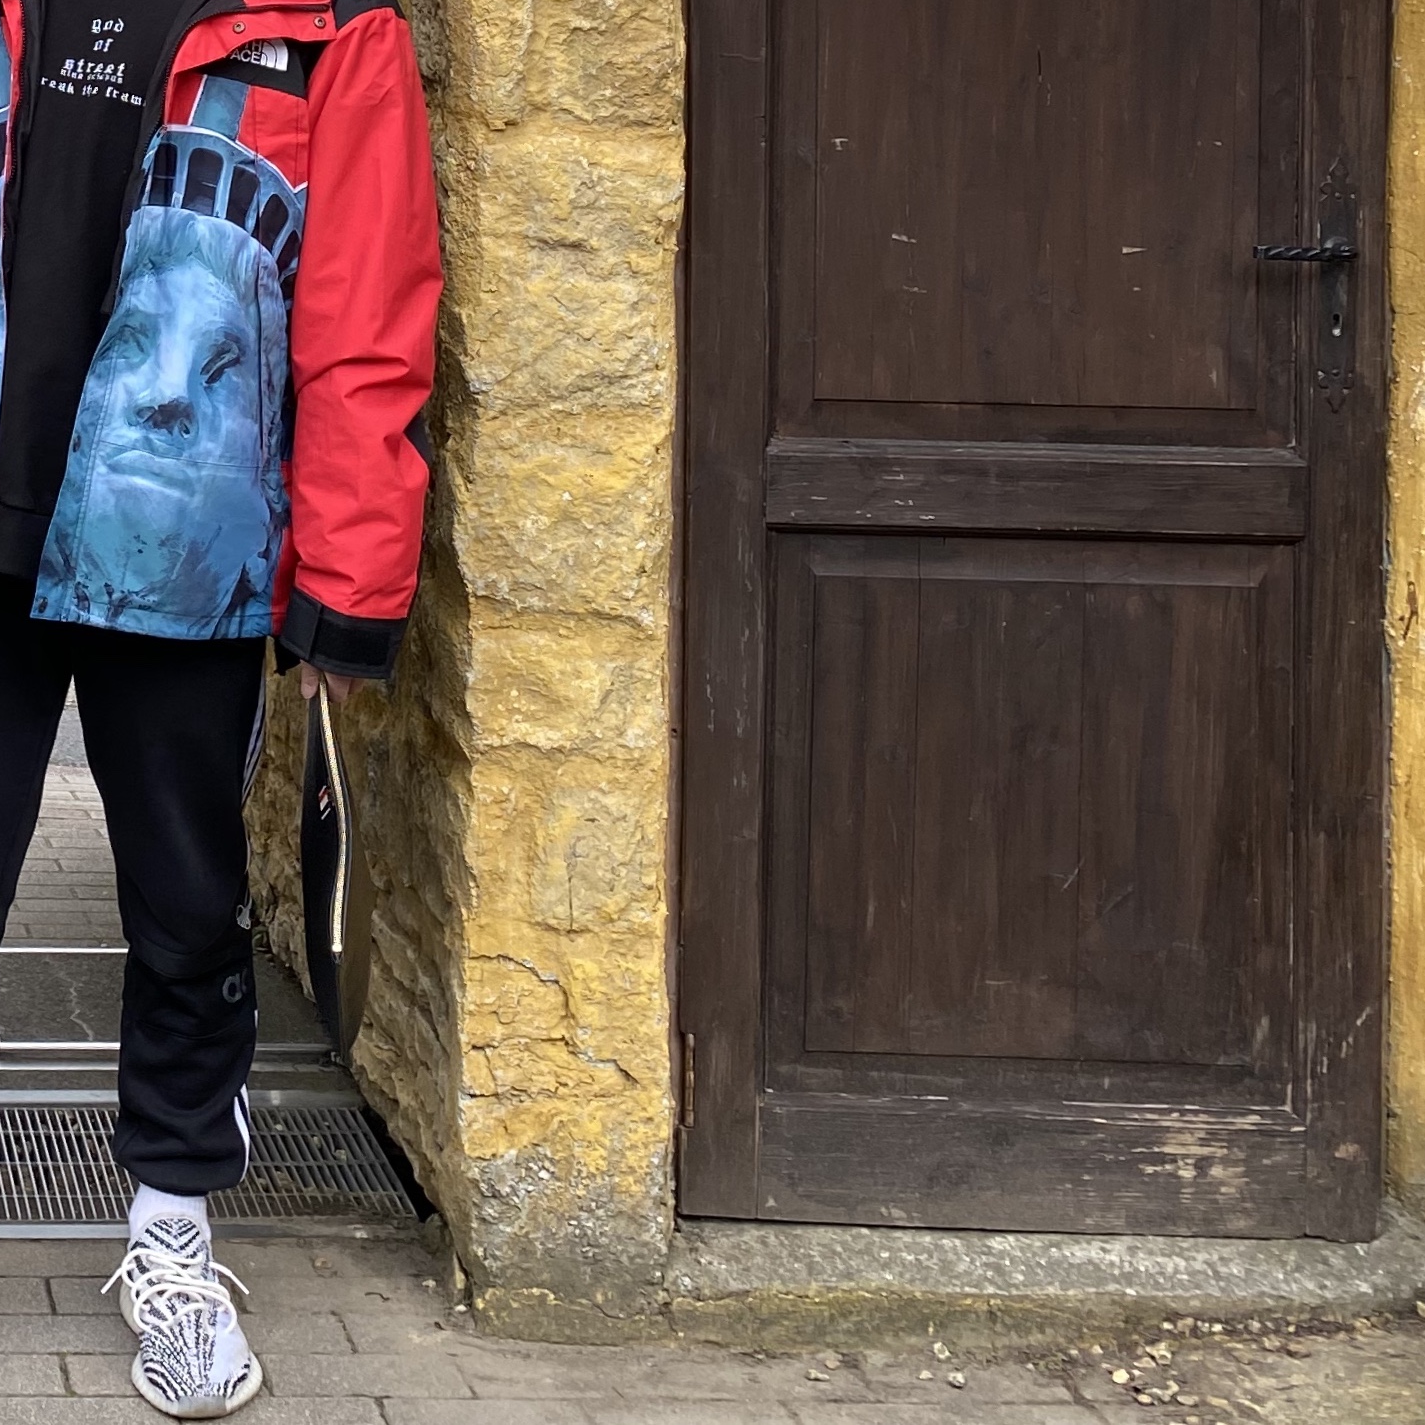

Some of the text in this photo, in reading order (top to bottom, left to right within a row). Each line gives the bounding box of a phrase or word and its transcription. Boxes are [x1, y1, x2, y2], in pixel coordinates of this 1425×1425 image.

[91, 18, 124, 33] god
[93, 38, 114, 52] of
[223, 49, 261, 65] ACE
[62, 58, 125, 76] street
[41, 77, 74, 94] reak
[106, 86, 147, 107] fram
